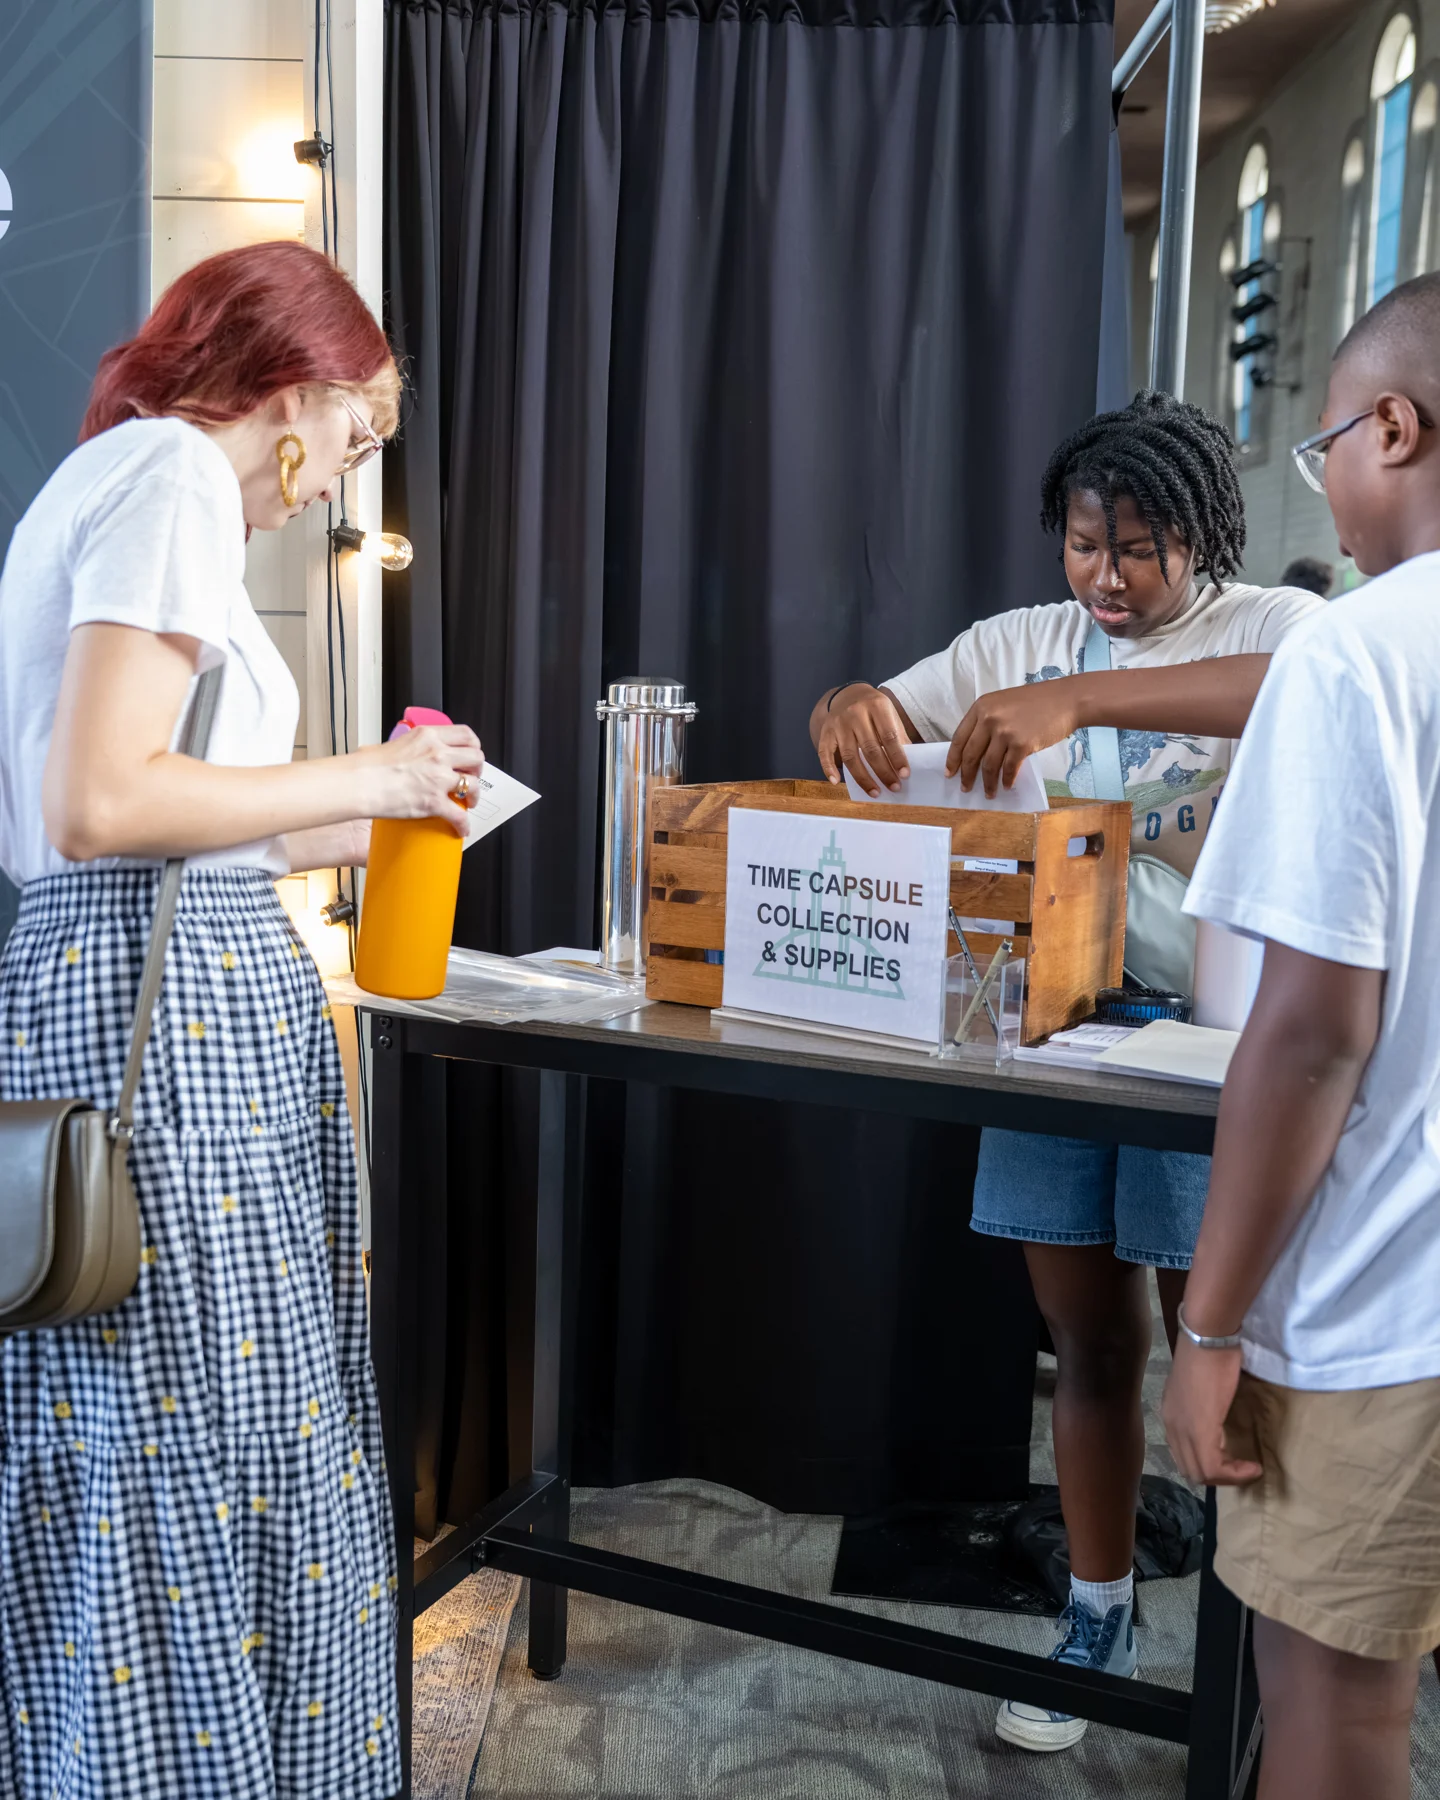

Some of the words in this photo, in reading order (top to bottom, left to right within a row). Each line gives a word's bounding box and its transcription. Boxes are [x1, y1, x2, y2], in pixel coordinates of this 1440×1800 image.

[1144, 796, 1219, 841] OG
[747, 864, 801, 891] TIME
[809, 872, 923, 907] CAPSULE
[757, 903, 909, 944] COLLECTION
[762, 940, 777, 963] &
[784, 943, 901, 982] SUPPLIES
